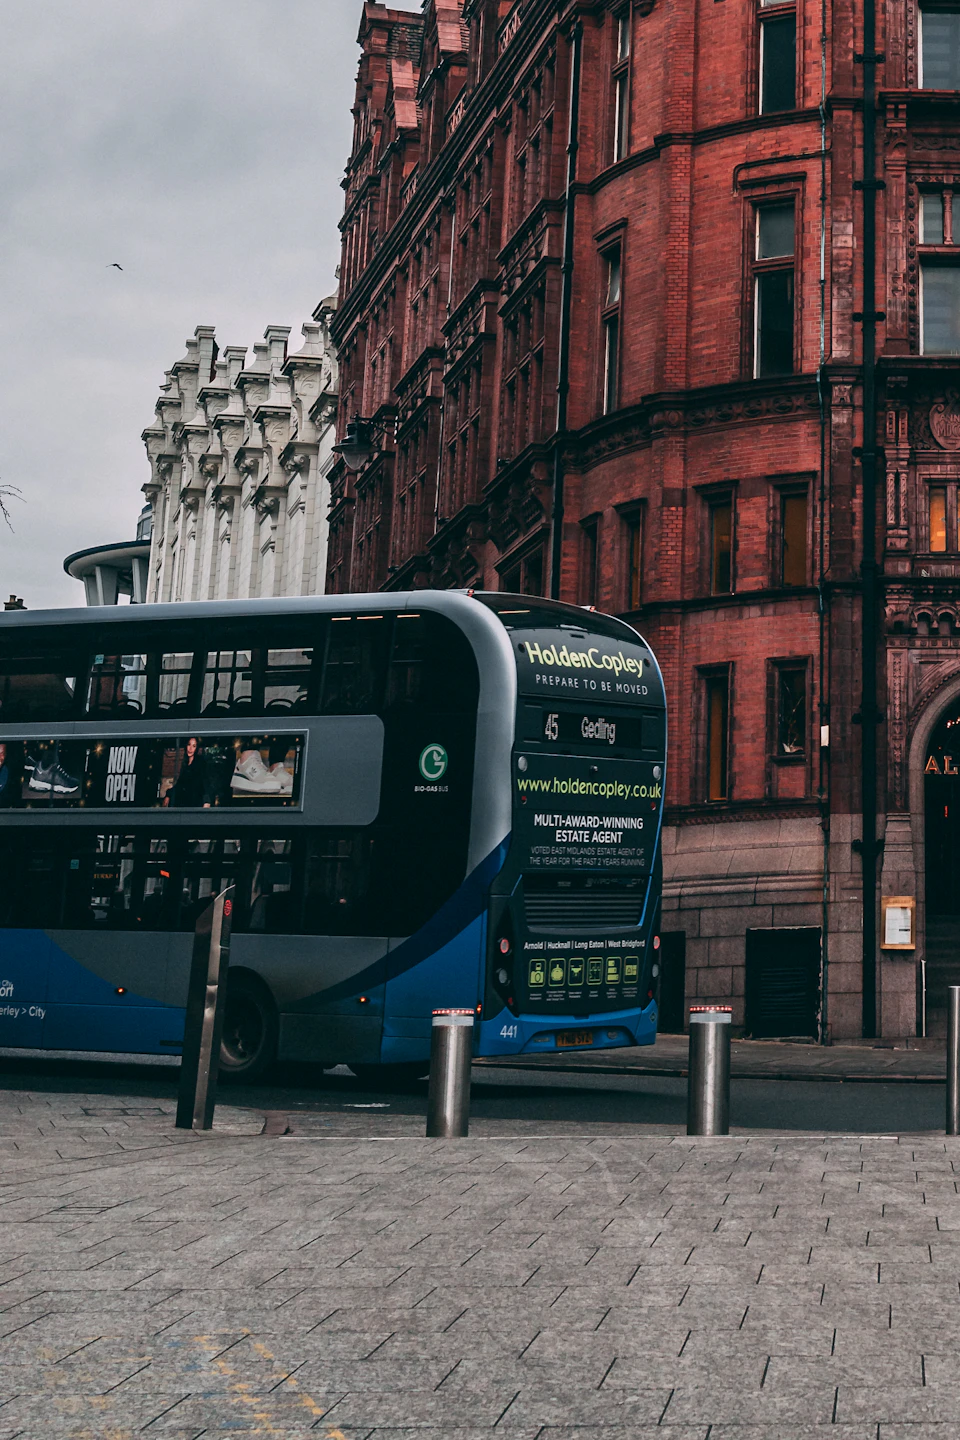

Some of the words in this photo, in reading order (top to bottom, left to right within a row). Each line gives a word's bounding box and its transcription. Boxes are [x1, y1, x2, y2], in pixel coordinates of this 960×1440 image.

[524, 641, 643, 679] HoldenCopley
[535, 673, 579, 689] PREPARE
[583, 679, 597, 690] TO
[601, 681, 612, 692] BE
[616, 683, 648, 696] MOVED
[544, 713, 559, 740] 45
[581, 716, 616, 745] Gedling
[107, 745, 138, 774] NOW
[105, 774, 137, 803] OPEN
[517, 776, 662, 800] www.holdencopley.co.uk
[534, 813, 644, 830] MULTI-AWARD-WINNING
[555, 830, 590, 843] ESTATE
[591, 831, 623, 844] AGENT
[530, 846, 551, 855] VOTED
[551, 846, 567, 855] EAST
[597, 847, 617, 856] ESTATE
[617, 848, 636, 856] AGENT
[636, 848, 645, 856] OF
[529, 856, 541, 865] THE
[542, 857, 557, 866] YEAR
[558, 857, 570, 866] FOR
[571, 857, 582, 866] THE
[582, 857, 597, 866] PAST
[597, 858, 602, 866] 2
[602, 858, 620, 866] YEARS
[620, 858, 645, 867] RUNNING
[524, 941, 543, 950] Arnold
[547, 941, 571, 950] Hucknall
[574, 940, 588, 950] Long
[589, 940, 604, 949] Eaton
[608, 939, 621, 948] West
[621, 939, 645, 949] Bridgford
[28, 1006, 46, 1019] City
[500, 1025, 518, 1038] 441
